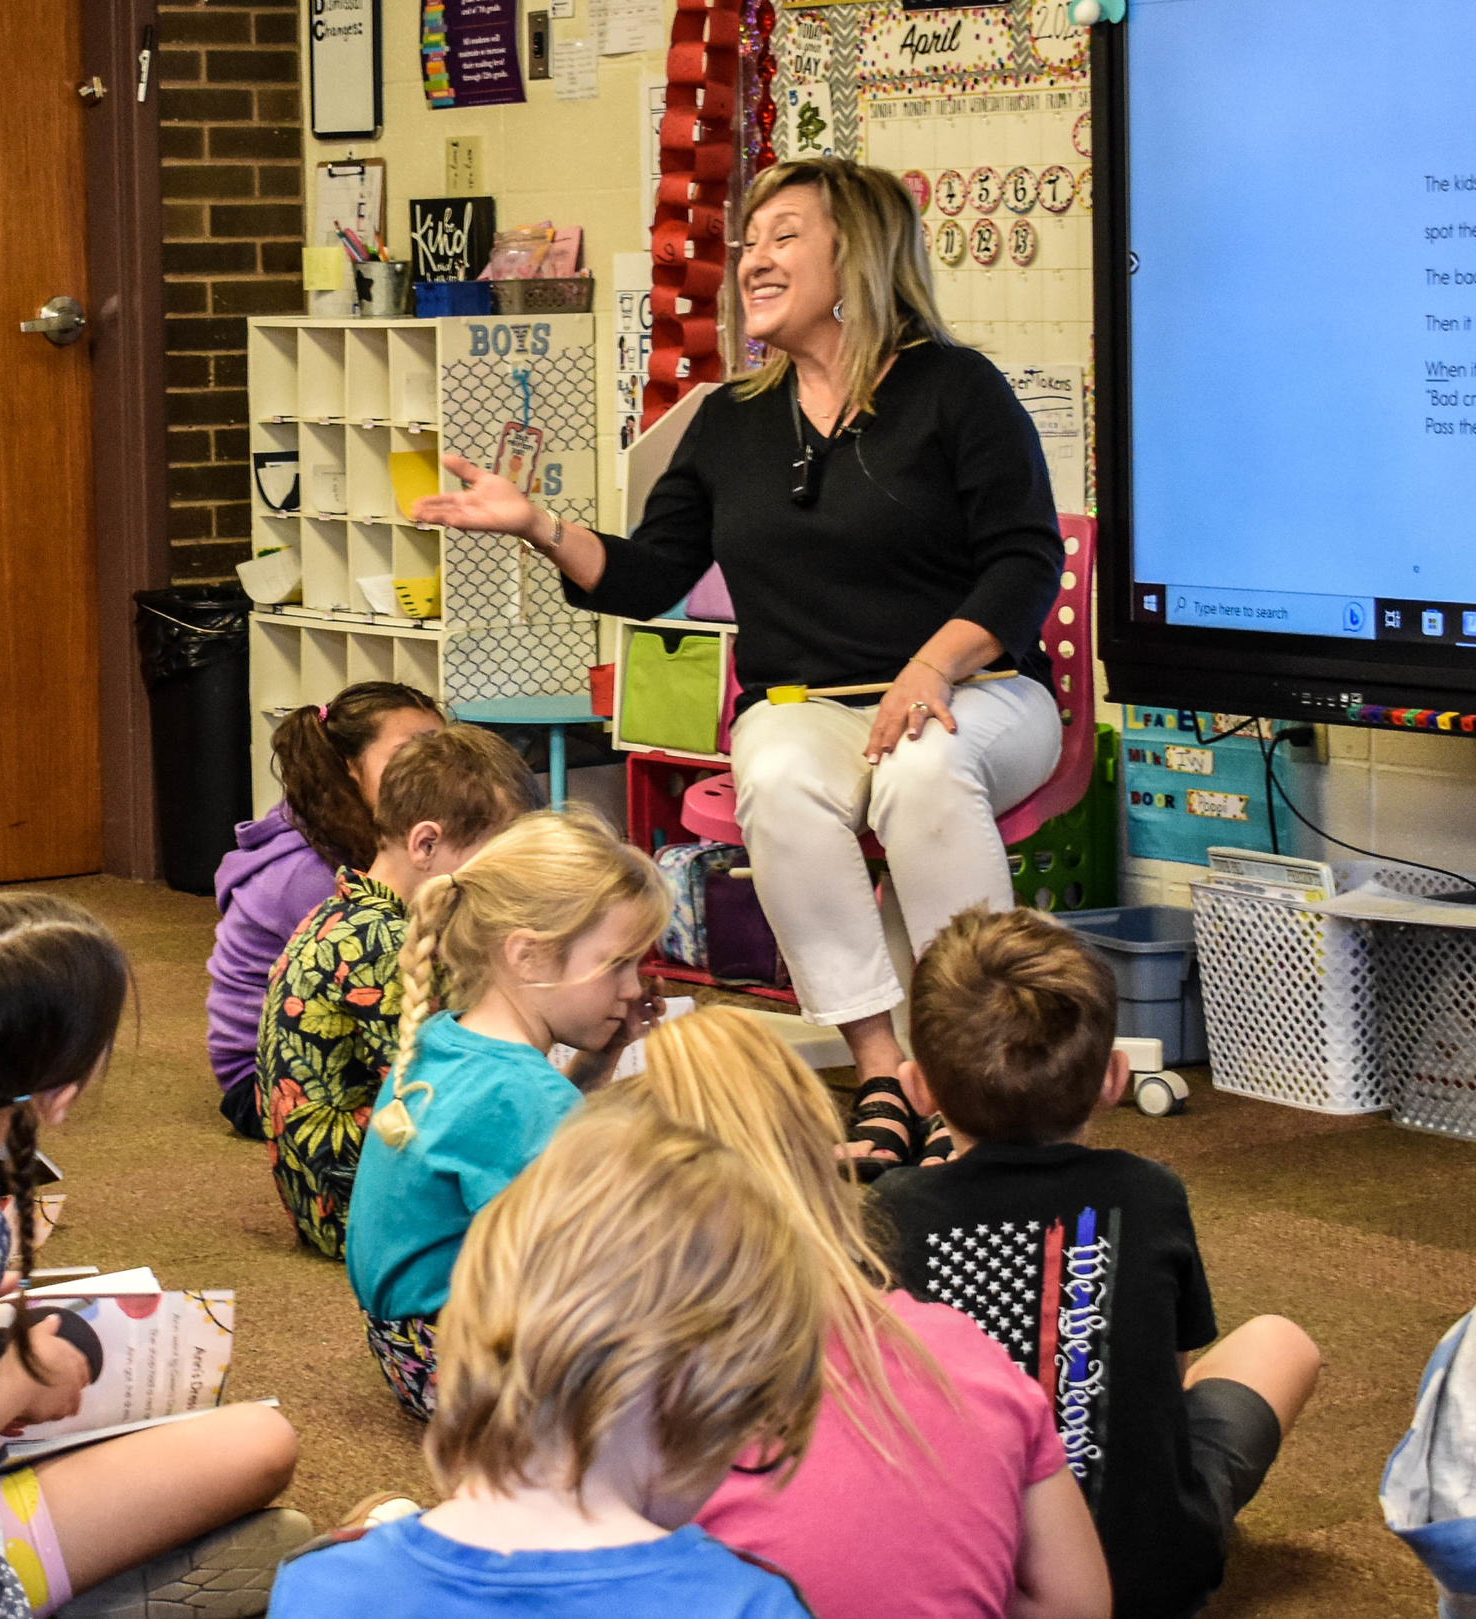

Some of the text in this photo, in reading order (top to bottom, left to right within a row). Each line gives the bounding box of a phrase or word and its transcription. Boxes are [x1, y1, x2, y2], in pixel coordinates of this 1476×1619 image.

[313, 20, 363, 42] Changes:
[900, 20, 964, 64] April
[795, 54, 821, 76] DAY
[788, 90, 799, 106] 5
[870, 102, 898, 118] SUNDAY
[903, 100, 932, 116] MONDAY
[936, 98, 966, 116] TUESDAY
[1005, 94, 1040, 112] THURSDAY
[1045, 92, 1072, 110] FRIDAY
[946, 180, 956, 204] 4
[978, 175, 990, 202] 5
[1014, 176, 1026, 203] 6
[1044, 175, 1060, 202] 7
[1425, 175, 1450, 192] The
[411, 201, 474, 276] Kind
[944, 228, 1028, 254] 11 12 13
[1424, 224, 1454, 244] spot
[1425, 268, 1450, 286] The
[1425, 314, 1472, 332] Then it
[469, 322, 550, 356] BOYS
[1424, 360, 1467, 378] When
[1425, 418, 1454, 436] Pass
[1192, 601, 1289, 620] Type here to search
[1176, 752, 1206, 771] Ivy
[1130, 790, 1175, 809] DOOR
[1059, 1236, 1112, 1303] We
[1058, 1304, 1107, 1362] the
